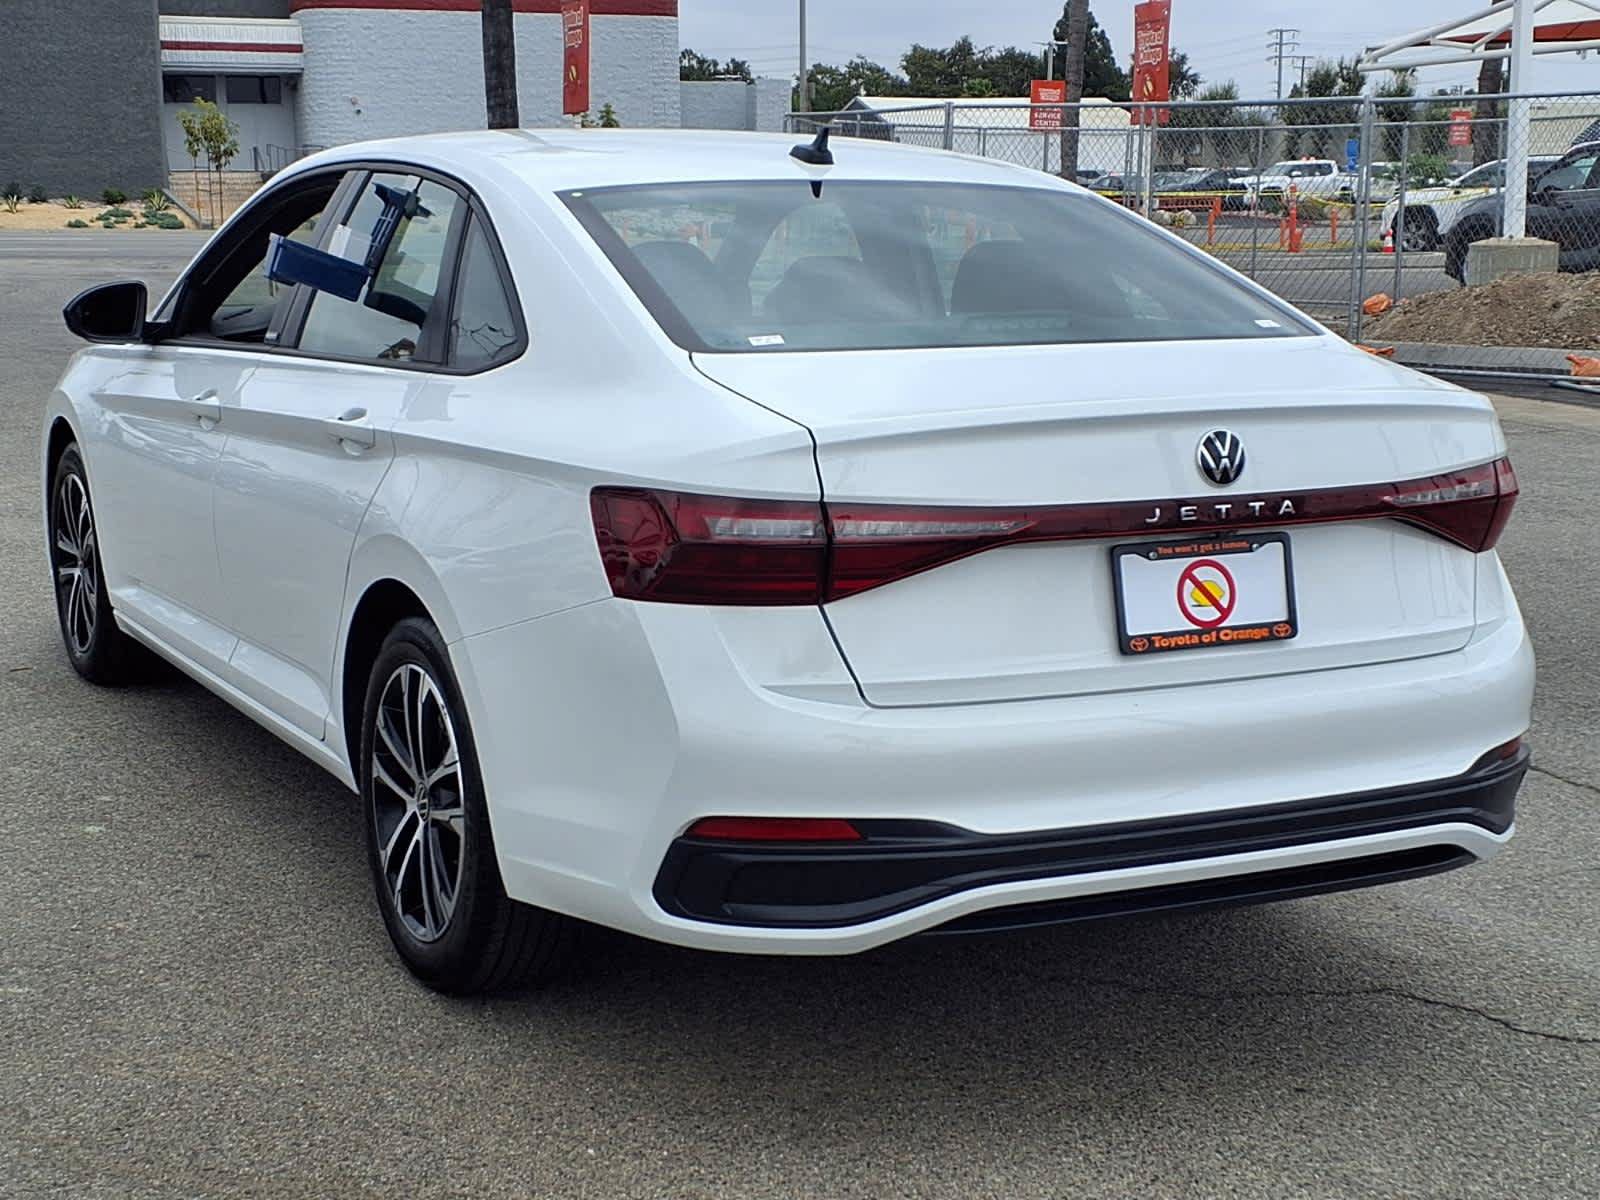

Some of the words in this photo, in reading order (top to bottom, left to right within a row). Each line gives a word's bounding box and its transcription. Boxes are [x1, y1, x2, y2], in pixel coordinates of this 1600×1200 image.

[1199, 430, 1246, 483] VW
[1145, 500, 1296, 523] JETTA
[1151, 634, 1199, 648] Toyota
[1201, 630, 1217, 642] of
[1220, 628, 1270, 641] Orange
